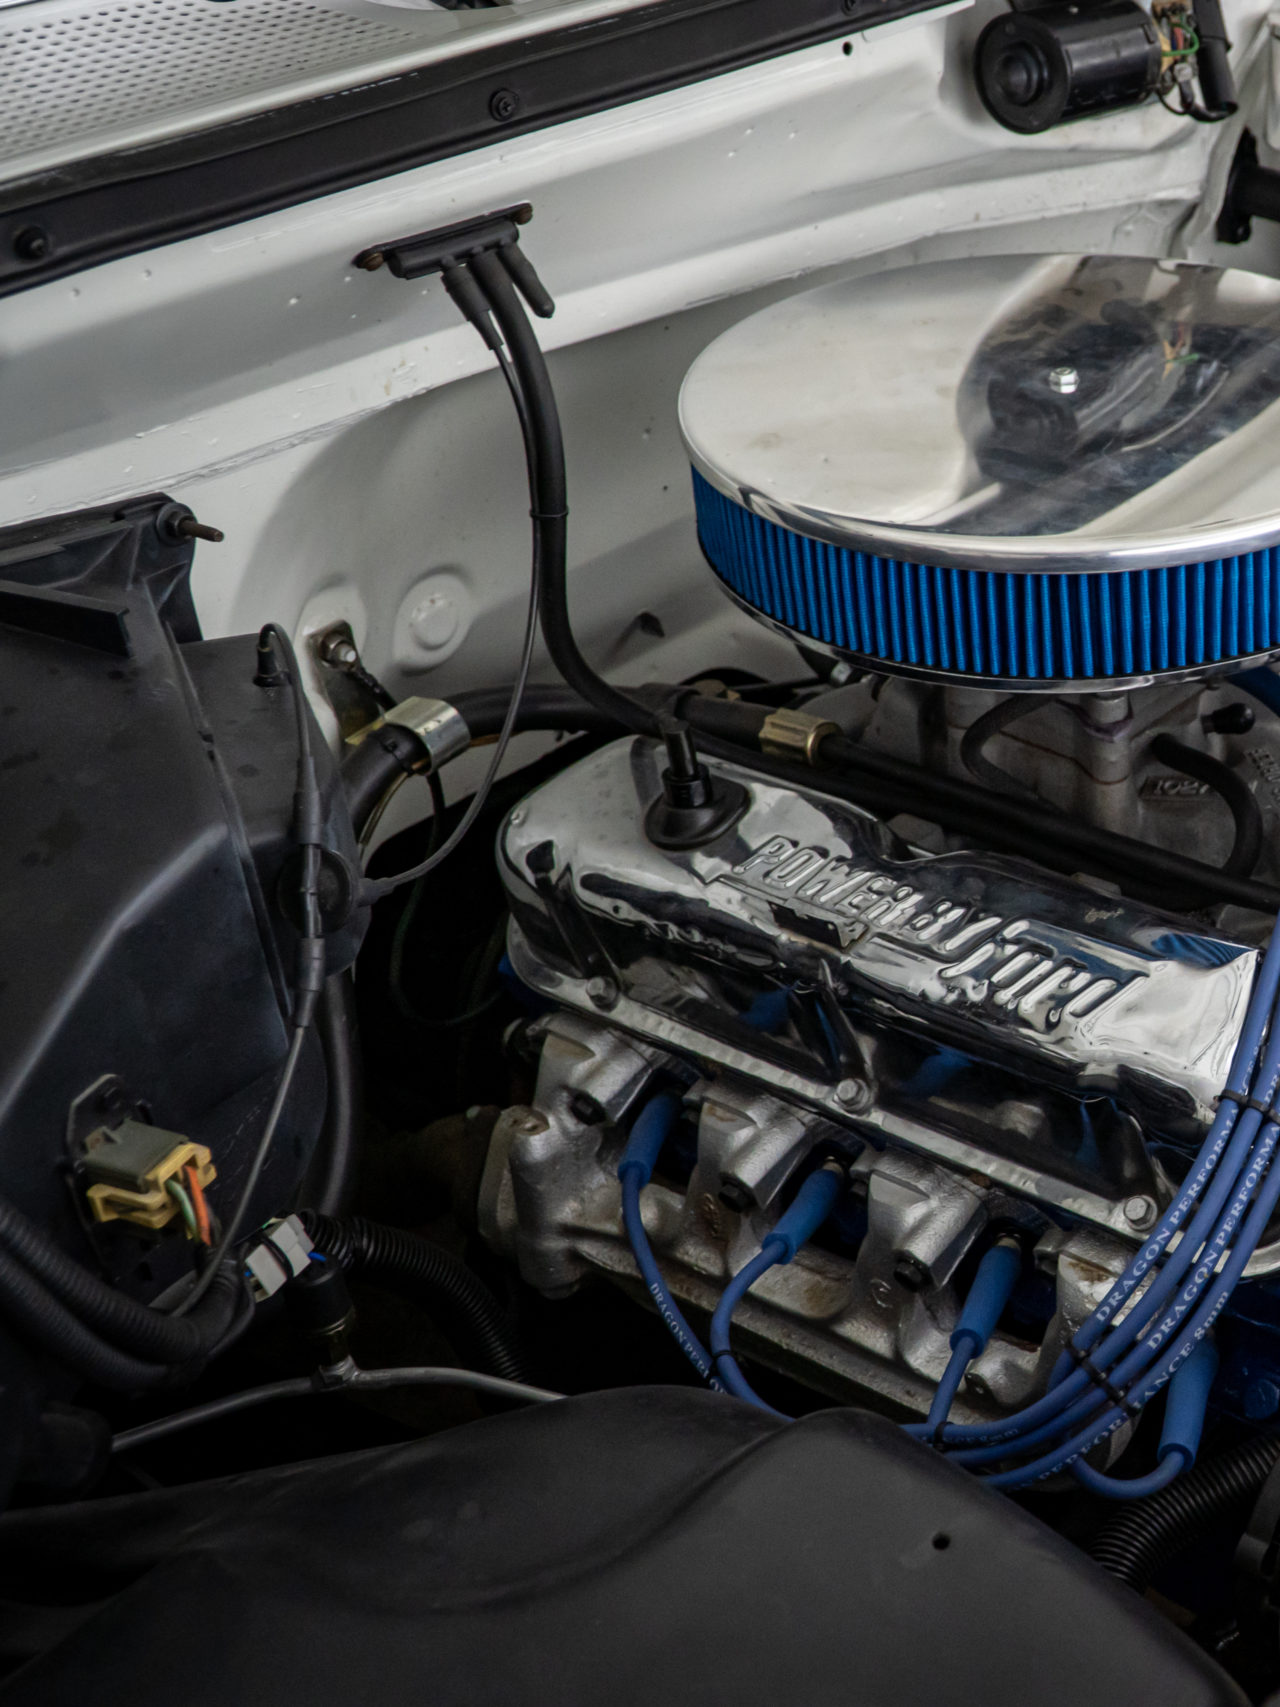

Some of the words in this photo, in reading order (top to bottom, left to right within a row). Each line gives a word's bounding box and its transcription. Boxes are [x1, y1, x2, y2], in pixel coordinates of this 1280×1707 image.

[732, 834, 926, 927] POWER
[650, 1282, 688, 1344] DRAGON
[1095, 1227, 1172, 1322] DRAGON
[1147, 1249, 1219, 1350] DRAGON
[1193, 1290, 1229, 1341] 8mm
